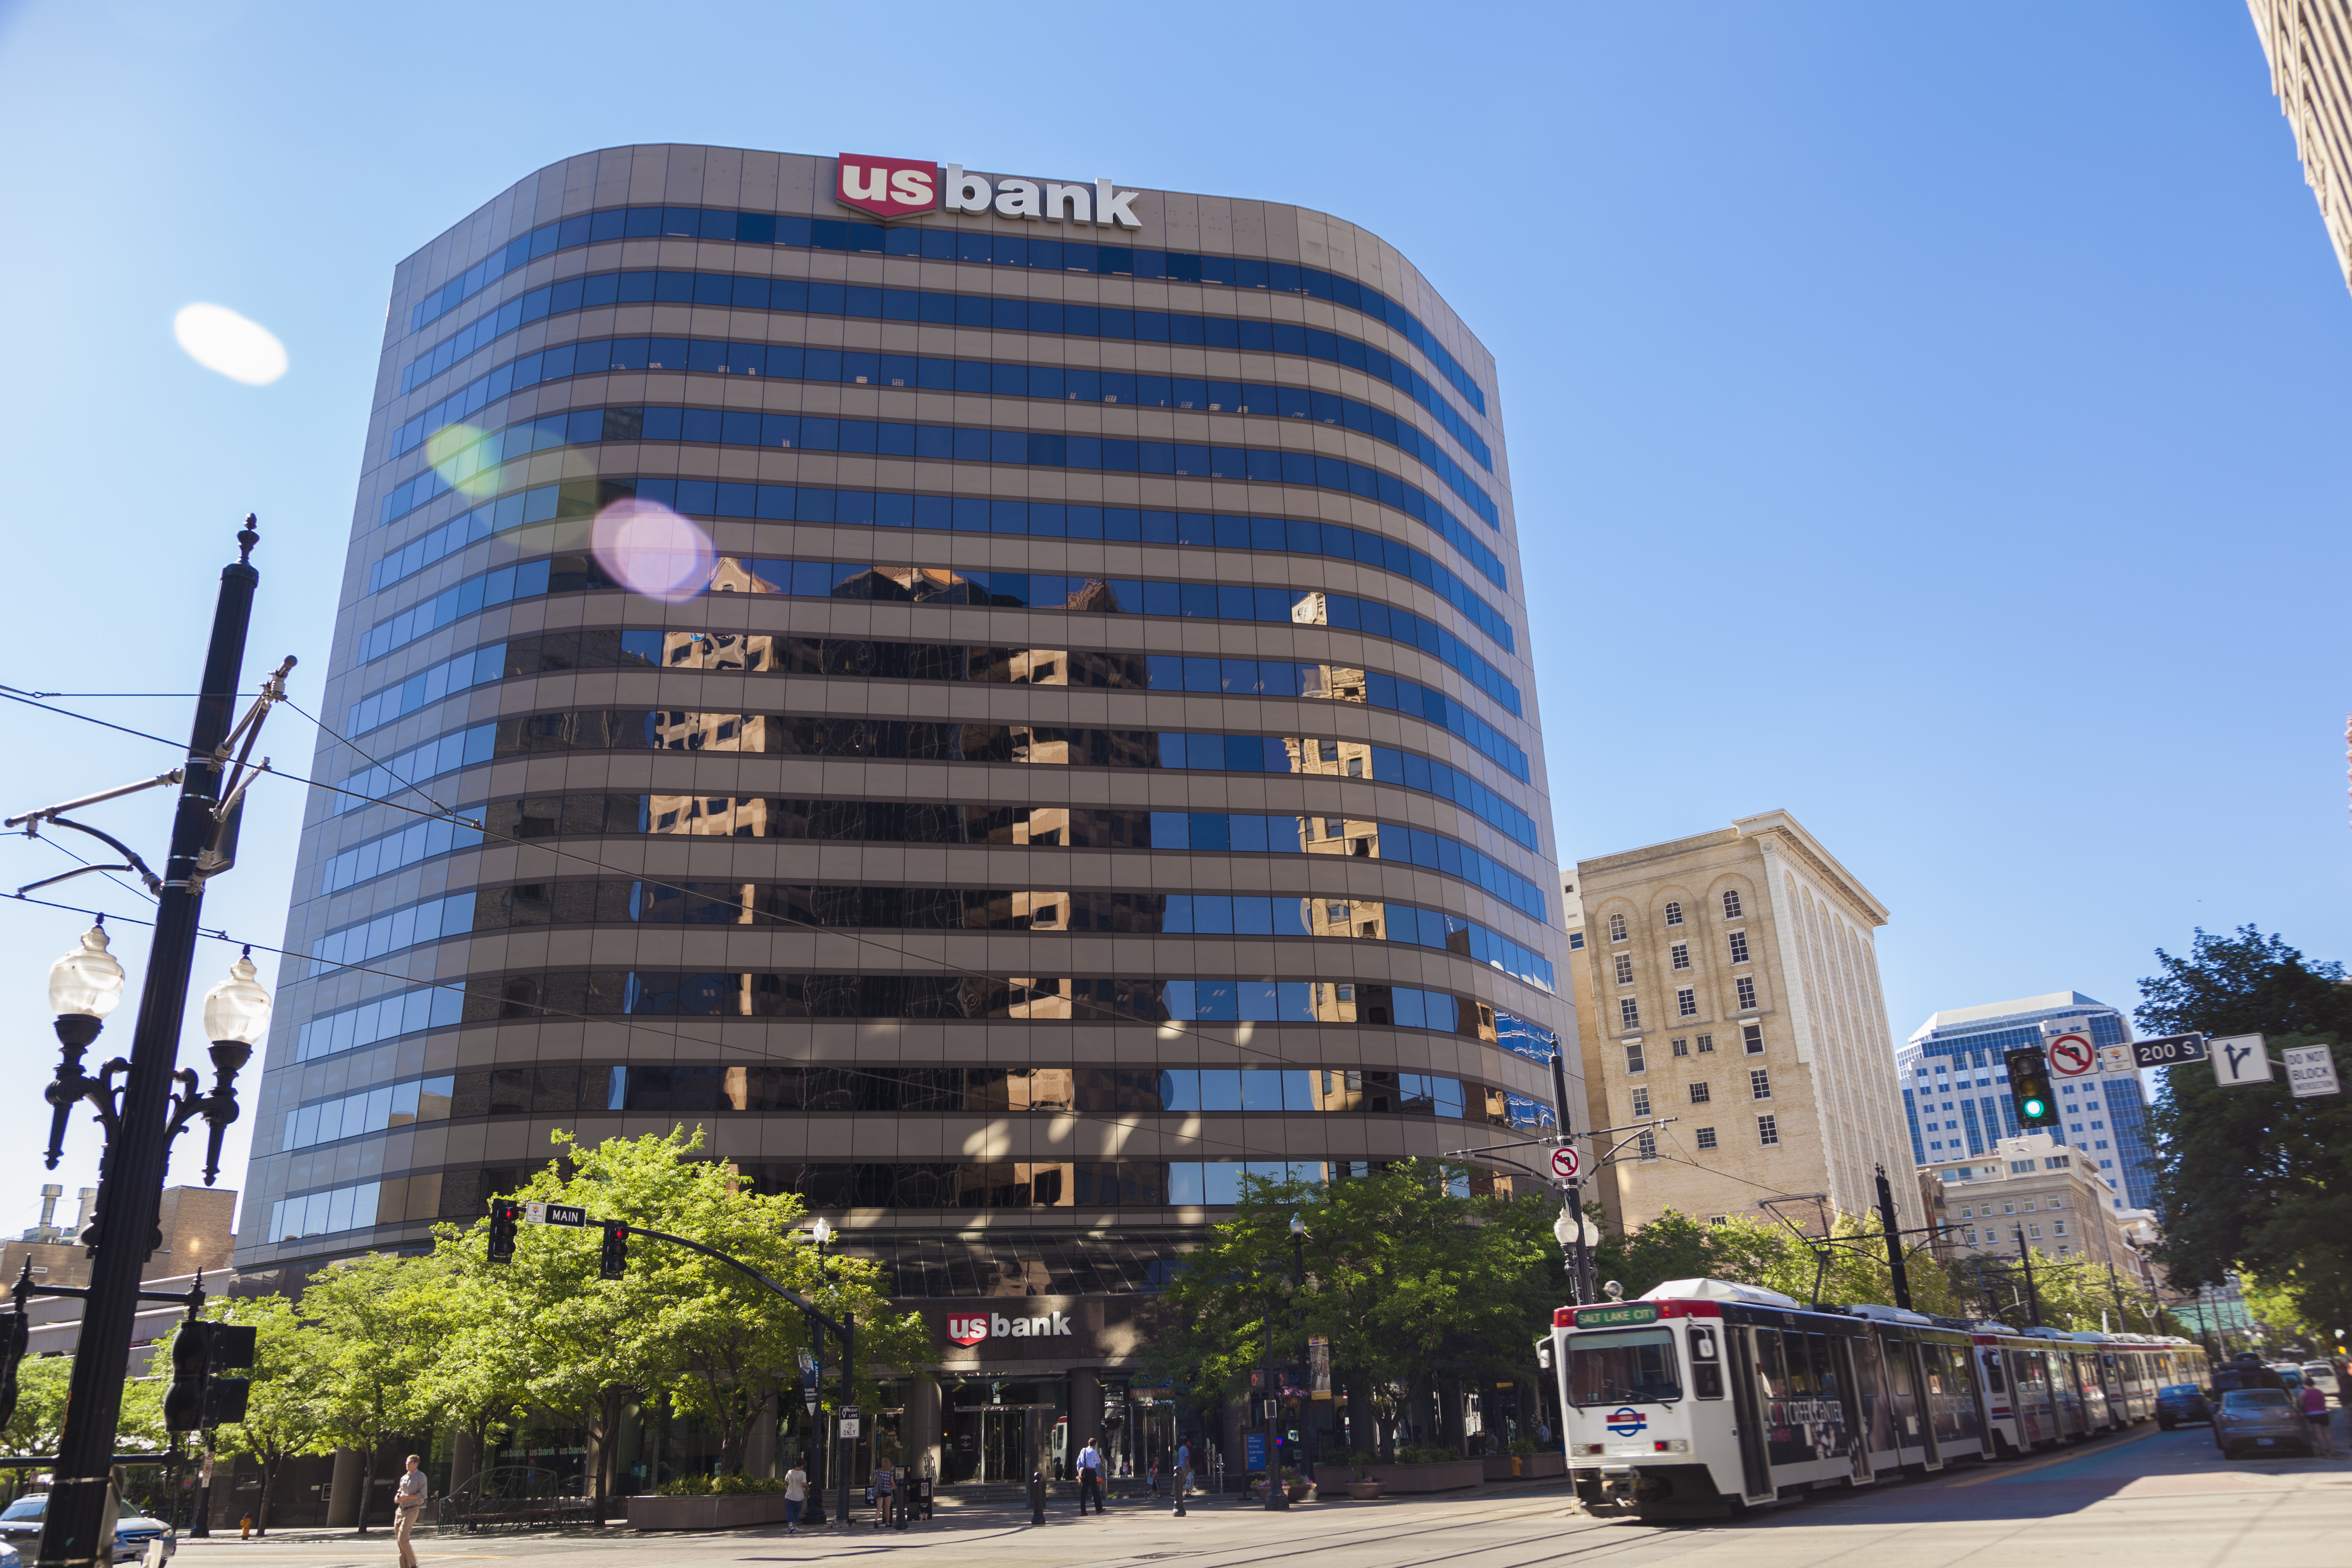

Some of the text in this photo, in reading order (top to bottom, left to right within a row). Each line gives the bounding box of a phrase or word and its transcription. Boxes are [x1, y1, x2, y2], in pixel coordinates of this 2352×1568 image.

[842, 162, 1143, 230] us bank
[2140, 1044, 2176, 1062] 200
[2288, 1050, 2326, 1065] DO NOT
[2292, 1066, 2332, 1080] BLOCK
[552, 1210, 578, 1222] MAIN
[1577, 1309, 1657, 1324] SALT LAKE CITY
[950, 1311, 1072, 1339] us bank
[508, 1448, 526, 1457] bank
[538, 1446, 555, 1456] bank
[568, 1445, 587, 1455] bank
